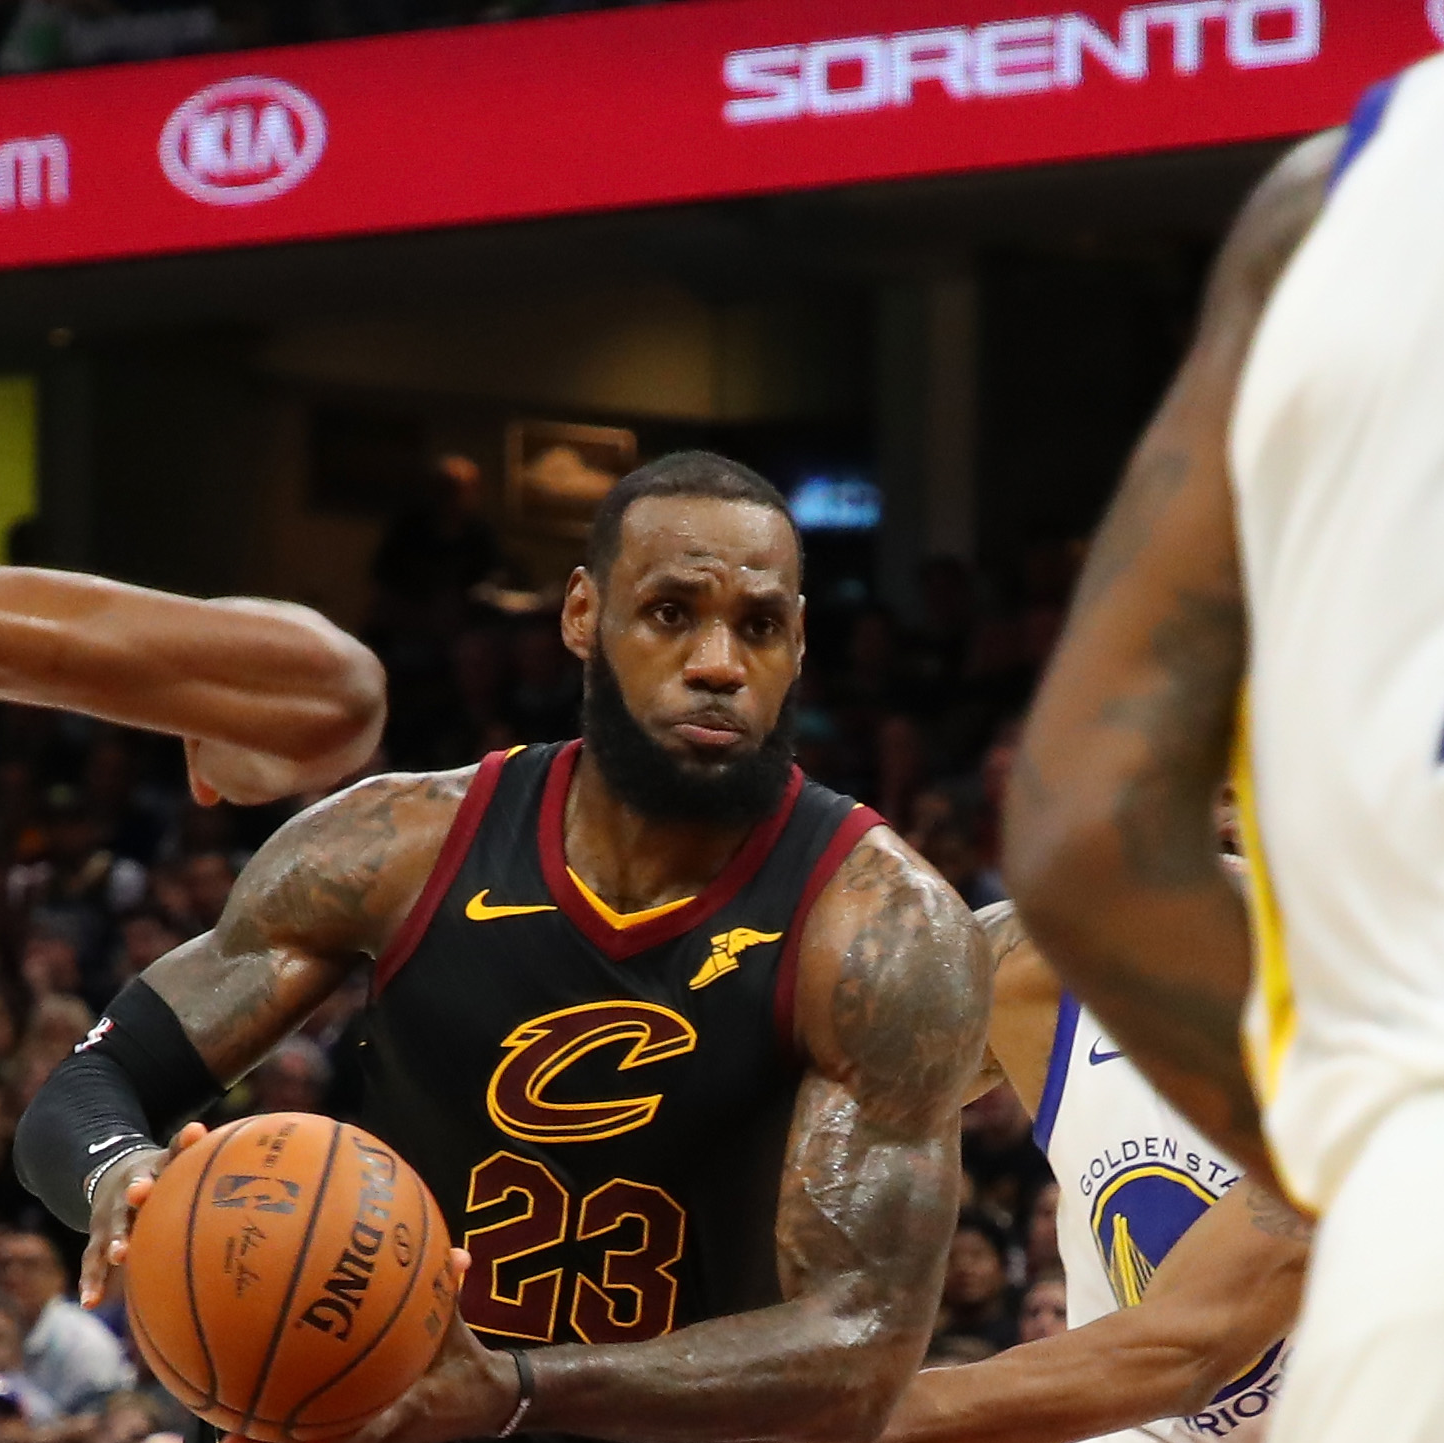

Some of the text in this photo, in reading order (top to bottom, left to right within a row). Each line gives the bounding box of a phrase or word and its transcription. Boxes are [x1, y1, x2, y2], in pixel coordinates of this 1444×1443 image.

[721, 0, 1322, 125] SORENTO
[1079, 1136, 1178, 1197] GOLDEN
[459, 1150, 686, 1345] 23
